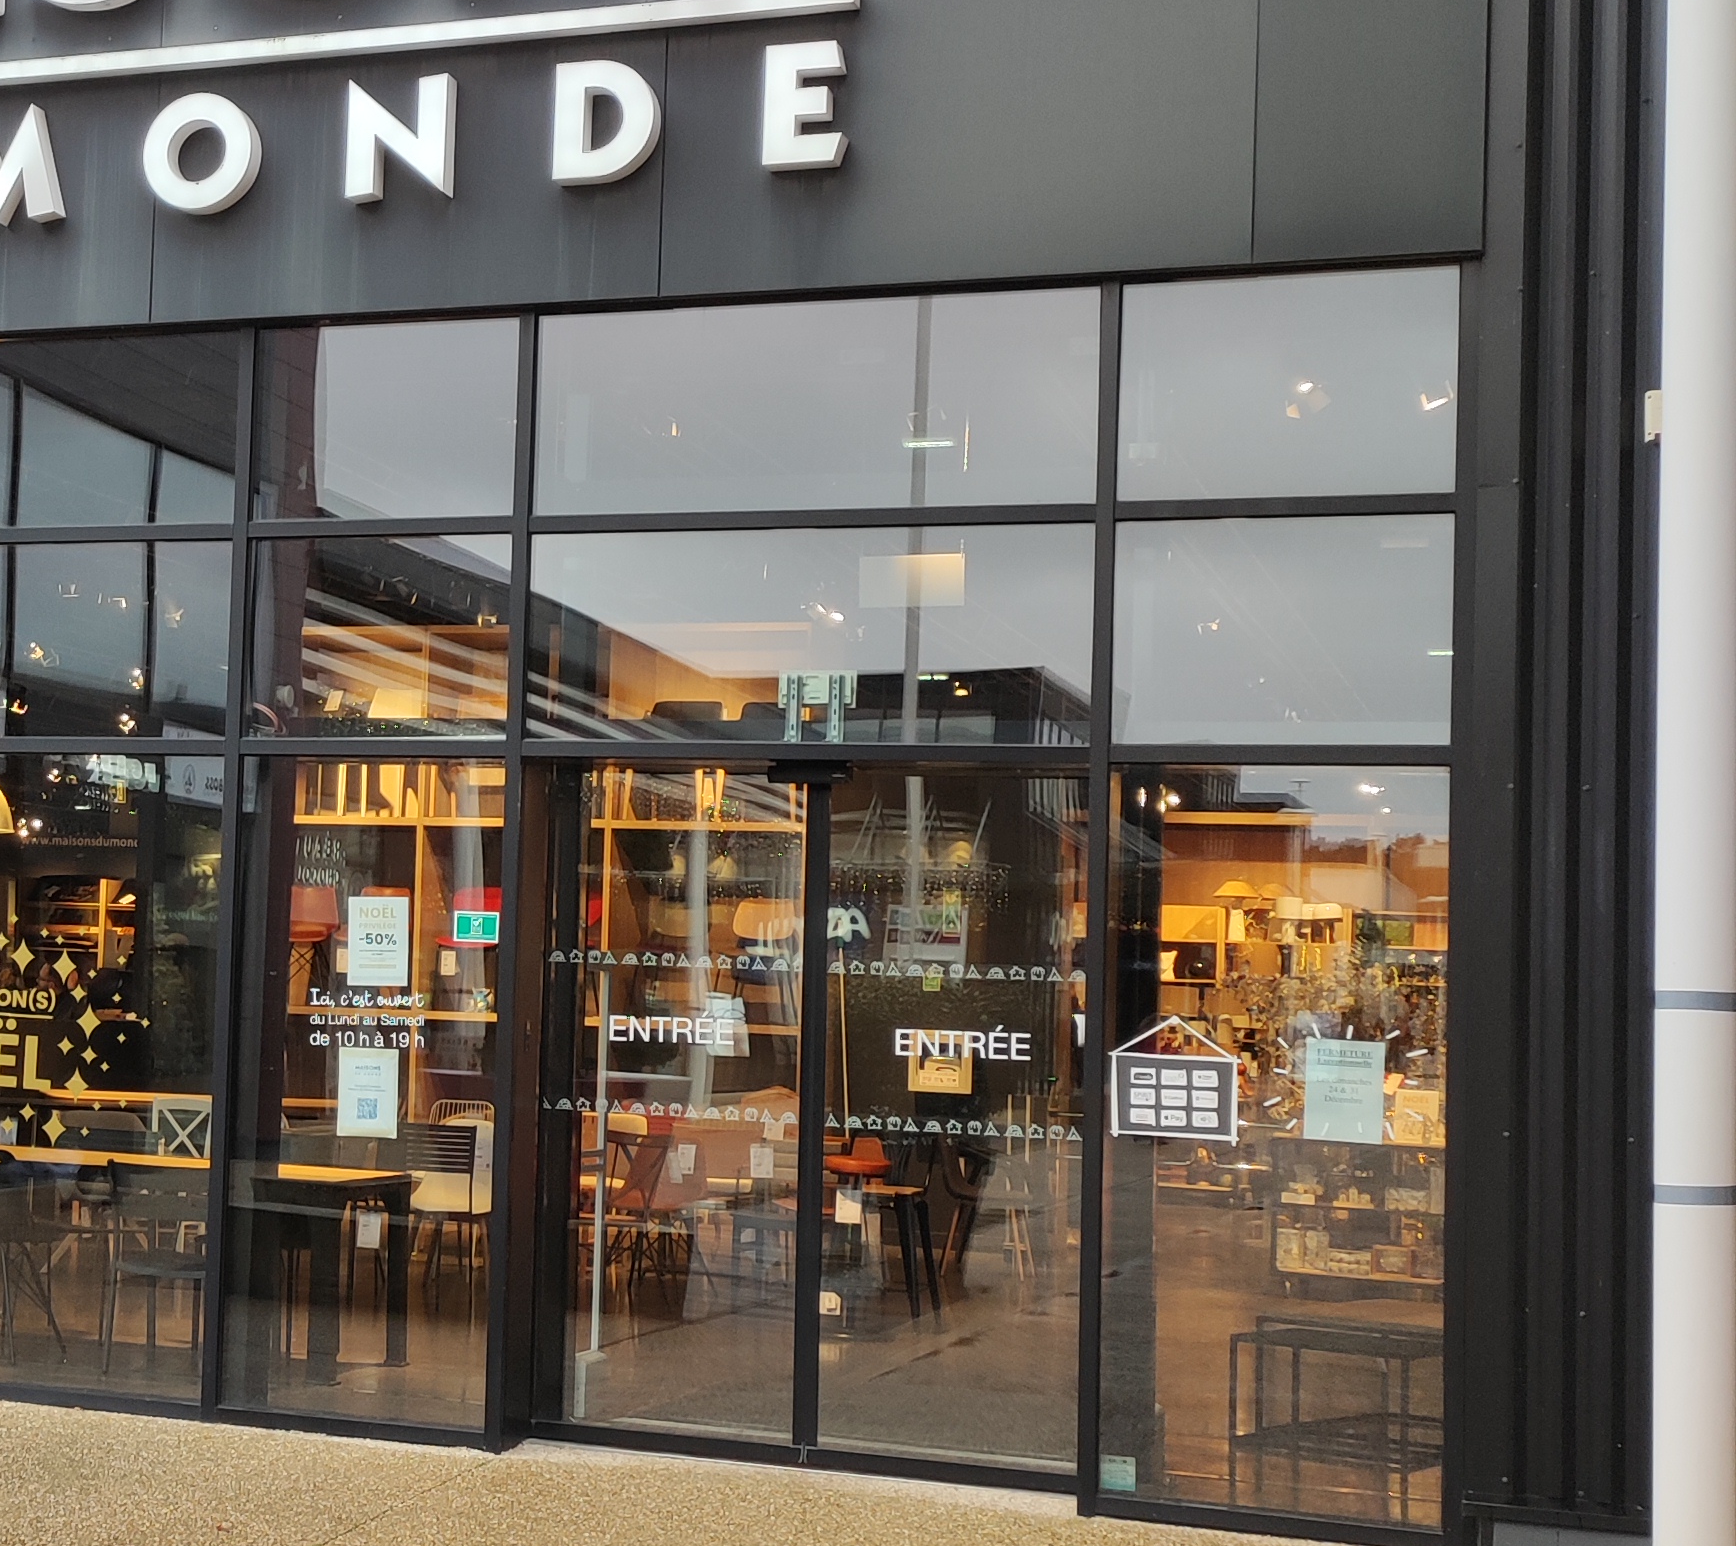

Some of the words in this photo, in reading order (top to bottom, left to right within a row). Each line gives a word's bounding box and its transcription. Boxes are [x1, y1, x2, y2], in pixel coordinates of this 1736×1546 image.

[358, 903, 398, 920] NOËL
[358, 932, 398, 946] -50%
[309, 987, 336, 1009] Ici,
[340, 988, 375, 1009] c'est
[376, 991, 425, 1009] ouvert
[309, 1013, 326, 1025] du
[327, 1013, 360, 1027] Lundi
[362, 1016, 378, 1027] au
[380, 1013, 425, 1028] Samedi
[607, 1010, 736, 1046] ENTRÉE
[309, 1030, 331, 1047] de
[335, 1031, 356, 1048] 10
[359, 1031, 370, 1048] h
[373, 1031, 385, 1048] à
[389, 1031, 410, 1049] 19
[414, 1032, 425, 1049] h
[893, 1024, 1032, 1062] ENTRÉE
[1316, 1047, 1373, 1059] FERMETURE
